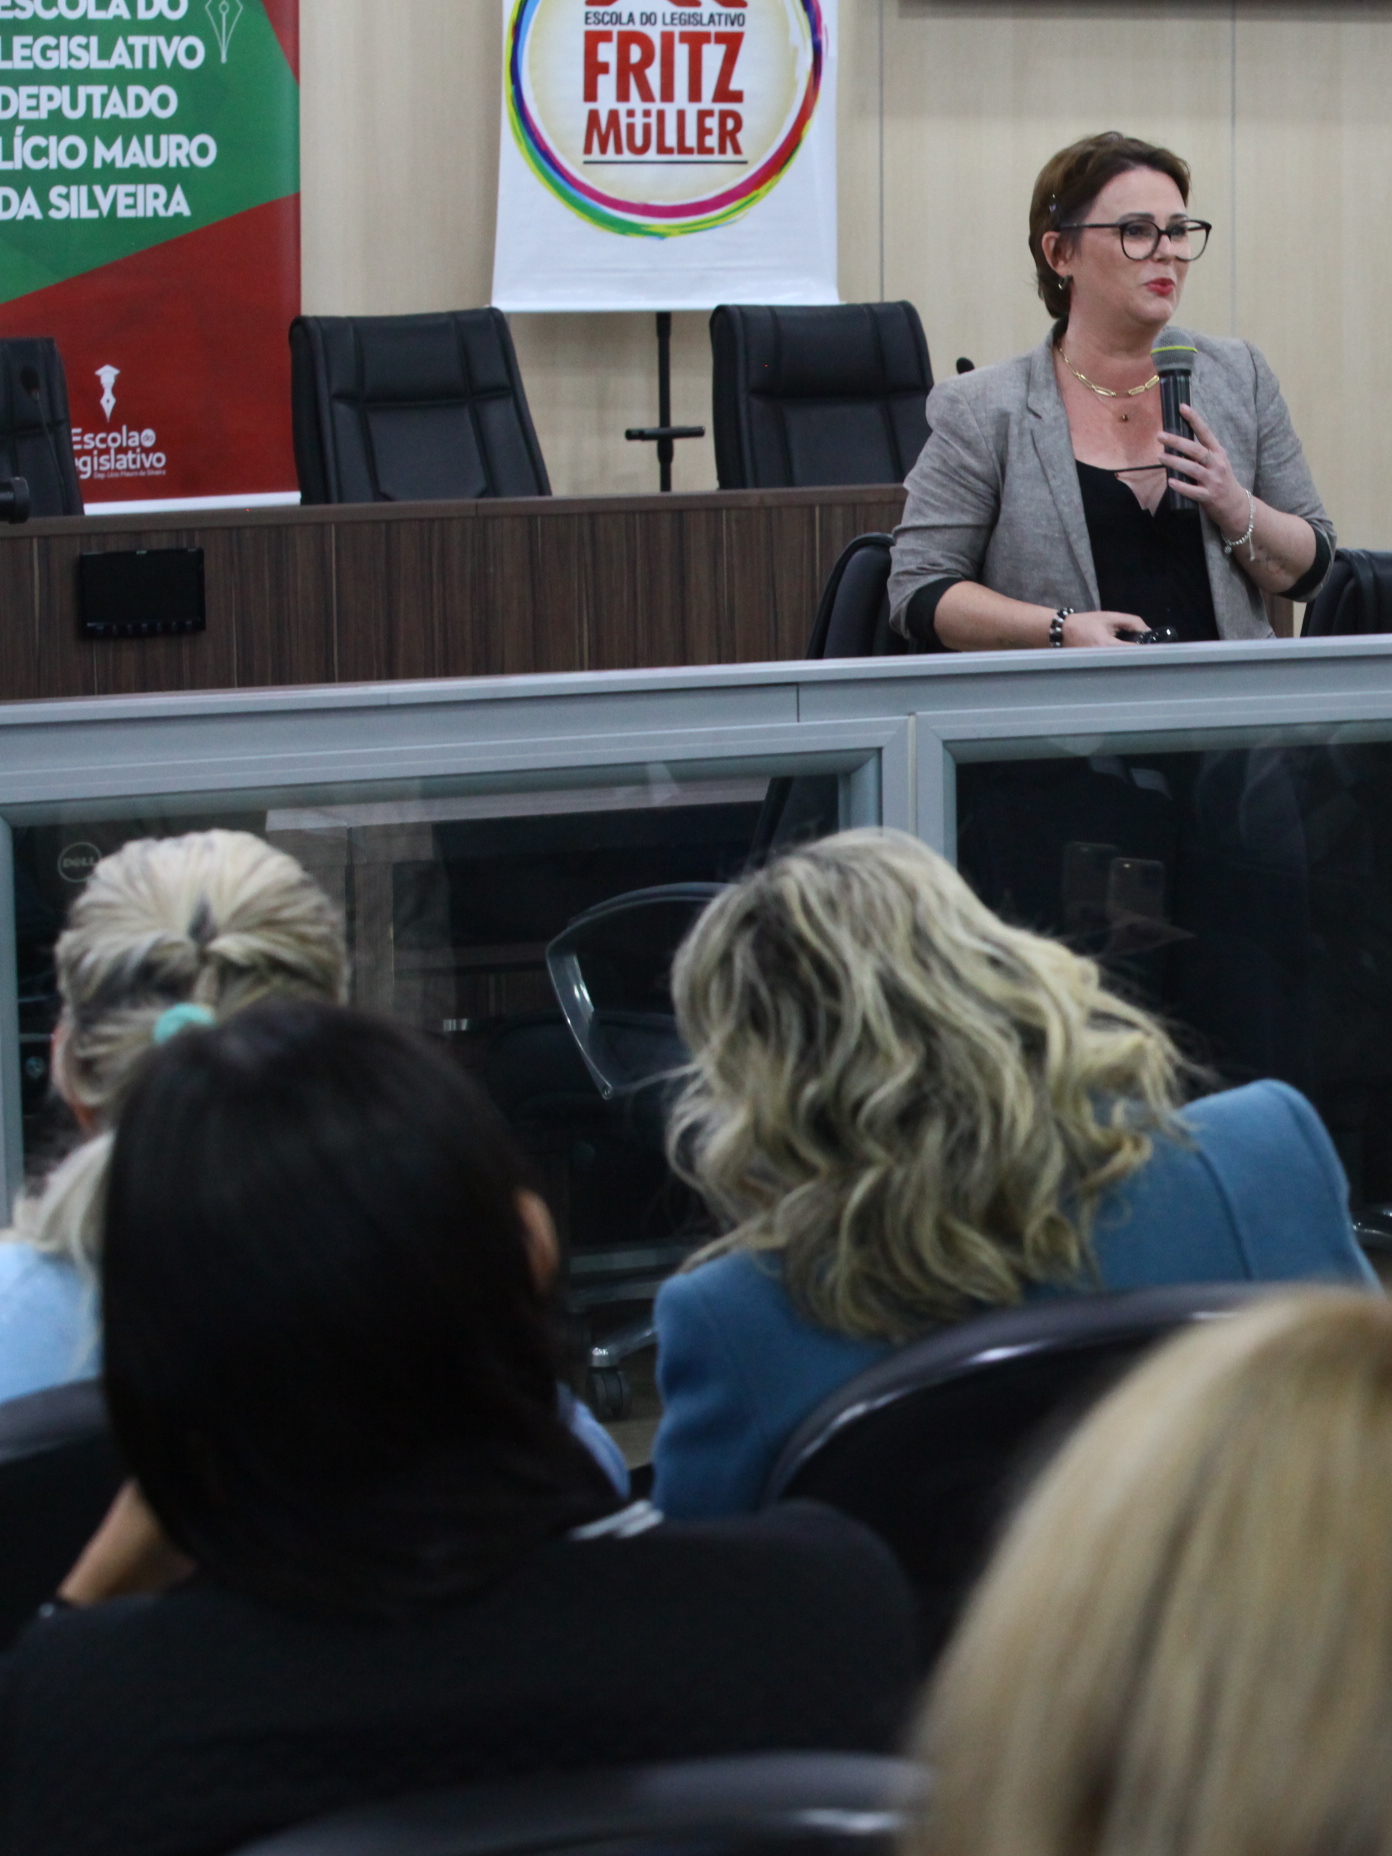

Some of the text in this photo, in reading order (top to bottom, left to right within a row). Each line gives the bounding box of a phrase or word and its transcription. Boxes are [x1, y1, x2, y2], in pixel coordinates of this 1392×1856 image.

[137, 0, 189, 20] DO
[584, 11, 746, 27] ESCOLA DO LEGISLATIVO
[583, 30, 746, 103] FRITZ
[0, 84, 179, 120] DEPUTADO
[583, 109, 744, 156] MÜLLER
[93, 133, 217, 168] MAURO
[0, 183, 192, 220] DA SILVEIRA
[71, 424, 140, 450] Escola
